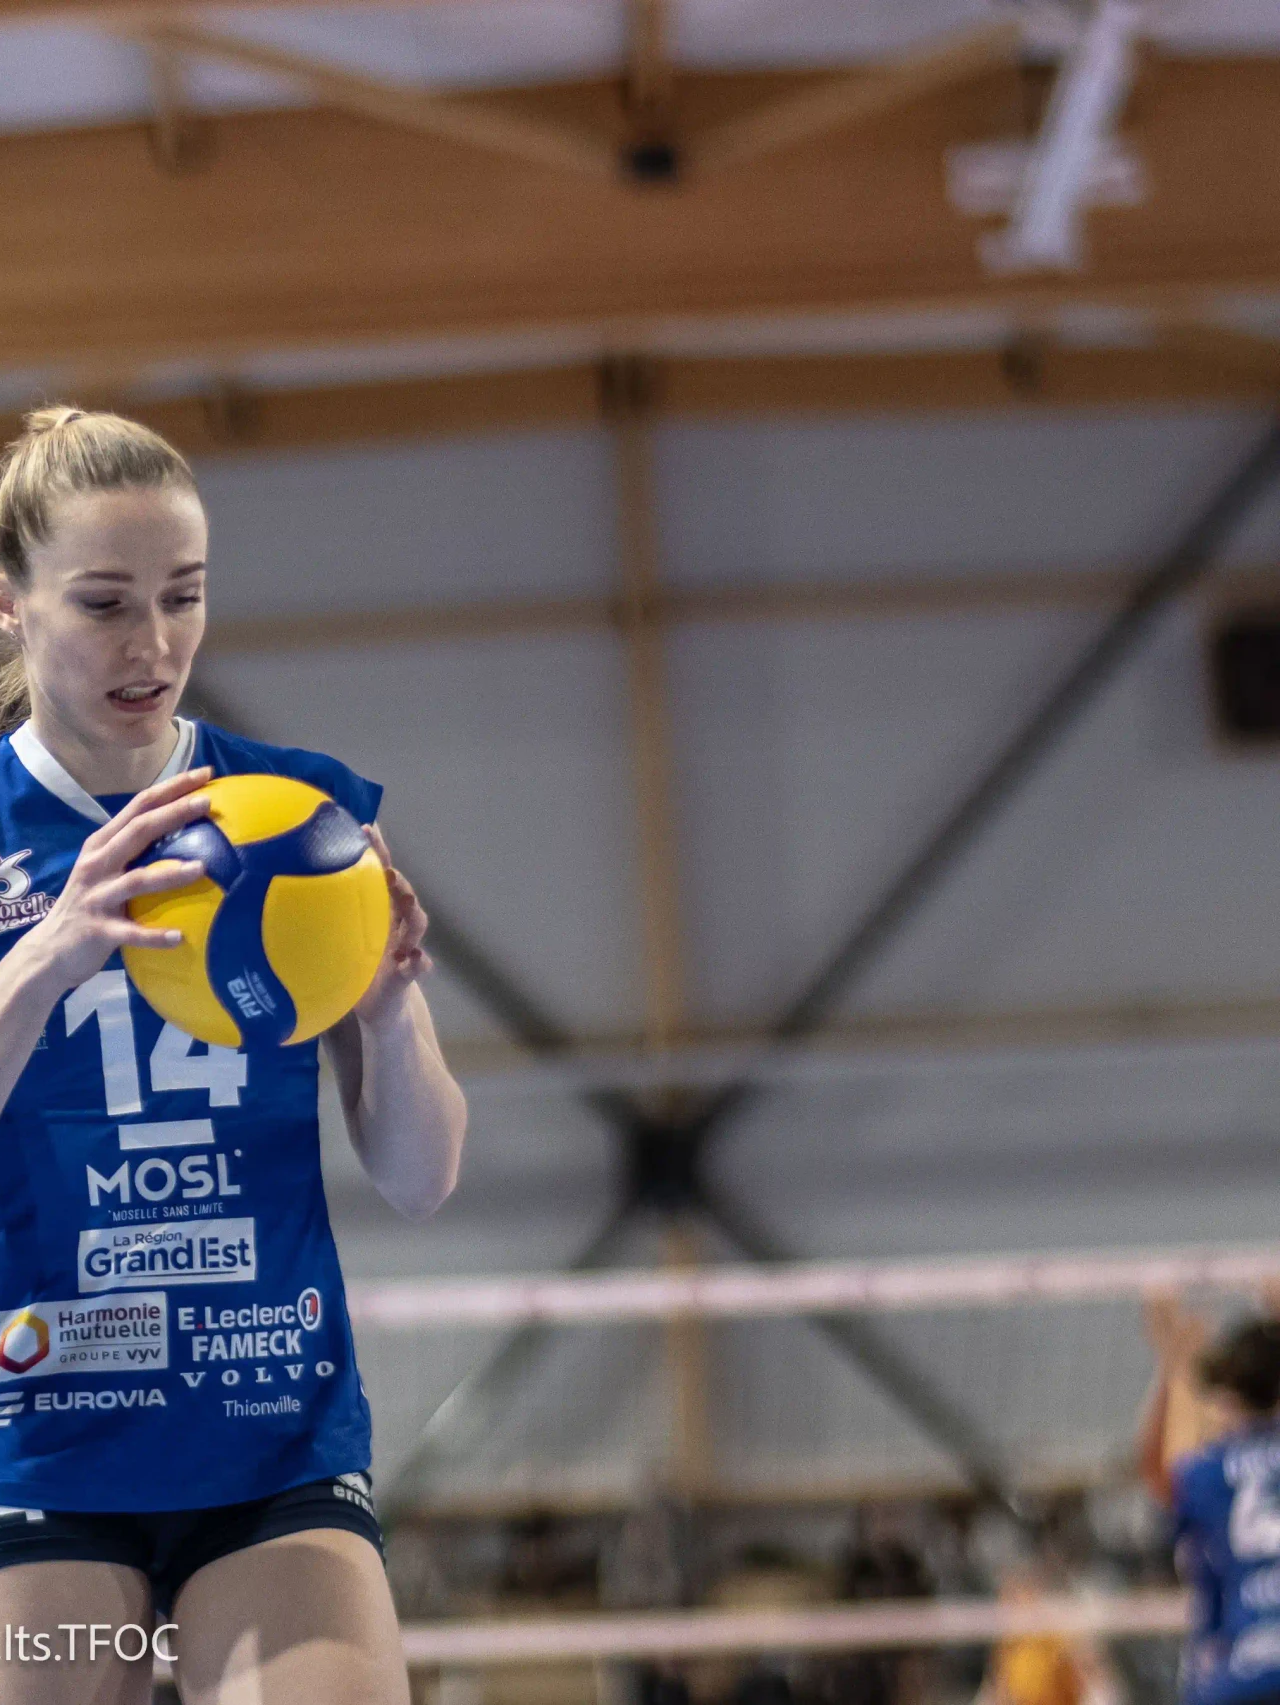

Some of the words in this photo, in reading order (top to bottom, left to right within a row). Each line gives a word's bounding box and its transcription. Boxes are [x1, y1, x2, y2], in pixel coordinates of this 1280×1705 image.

[227, 977, 263, 1019] FIVB
[64, 969, 247, 1116] 14
[111, 1207, 158, 1222] MOSELLE
[163, 1204, 190, 1218] SANS
[193, 1202, 224, 1215] LIMITE
[113, 1235, 131, 1247] La
[135, 1231, 182, 1246] Région
[58, 1303, 161, 1328] Harmonie
[177, 1303, 296, 1331] E.Leclerc
[59, 1321, 161, 1343] mutuelle
[59, 1350, 120, 1364] GROUPE
[191, 1329, 303, 1362] FAMECK
[179, 1361, 336, 1388] VOLVO
[34, 1388, 168, 1412] EUROVIA
[222, 1395, 302, 1418] Thionville
